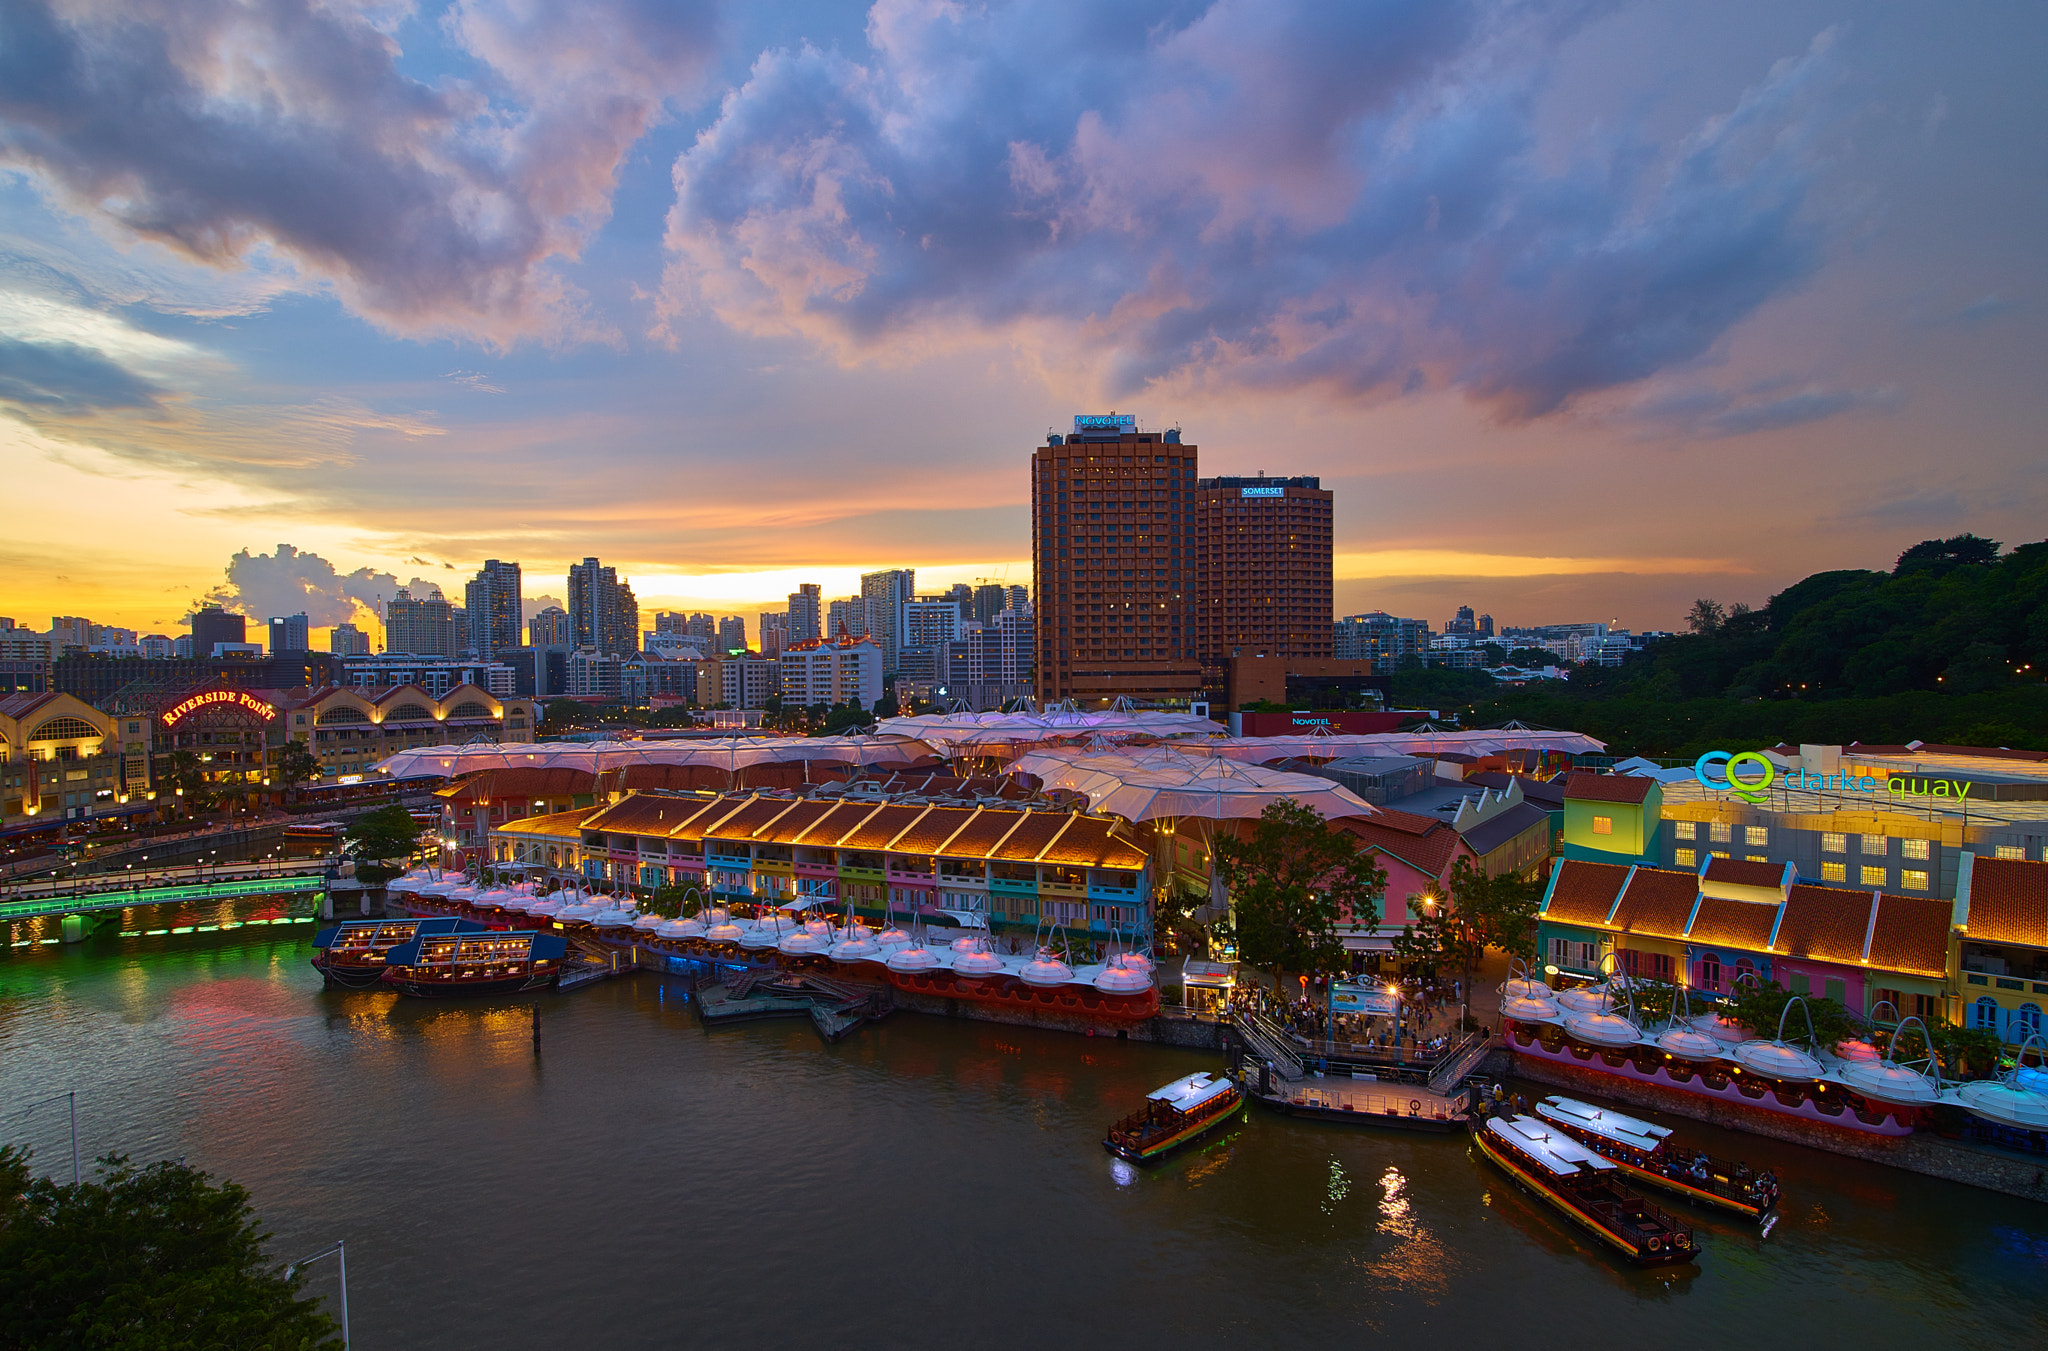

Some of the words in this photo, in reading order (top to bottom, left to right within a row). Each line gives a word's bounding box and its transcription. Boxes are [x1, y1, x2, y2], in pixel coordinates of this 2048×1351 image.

[1075, 415, 1134, 425] NOVOTEL
[1243, 487, 1283, 495] SOMERSET
[162, 691, 237, 727] RIVERSIDE
[238, 692, 276, 721] POINT
[1292, 718, 1331, 726] NOVOTEL
[1784, 767, 1876, 793] clarke
[1887, 777, 1972, 804] quay
